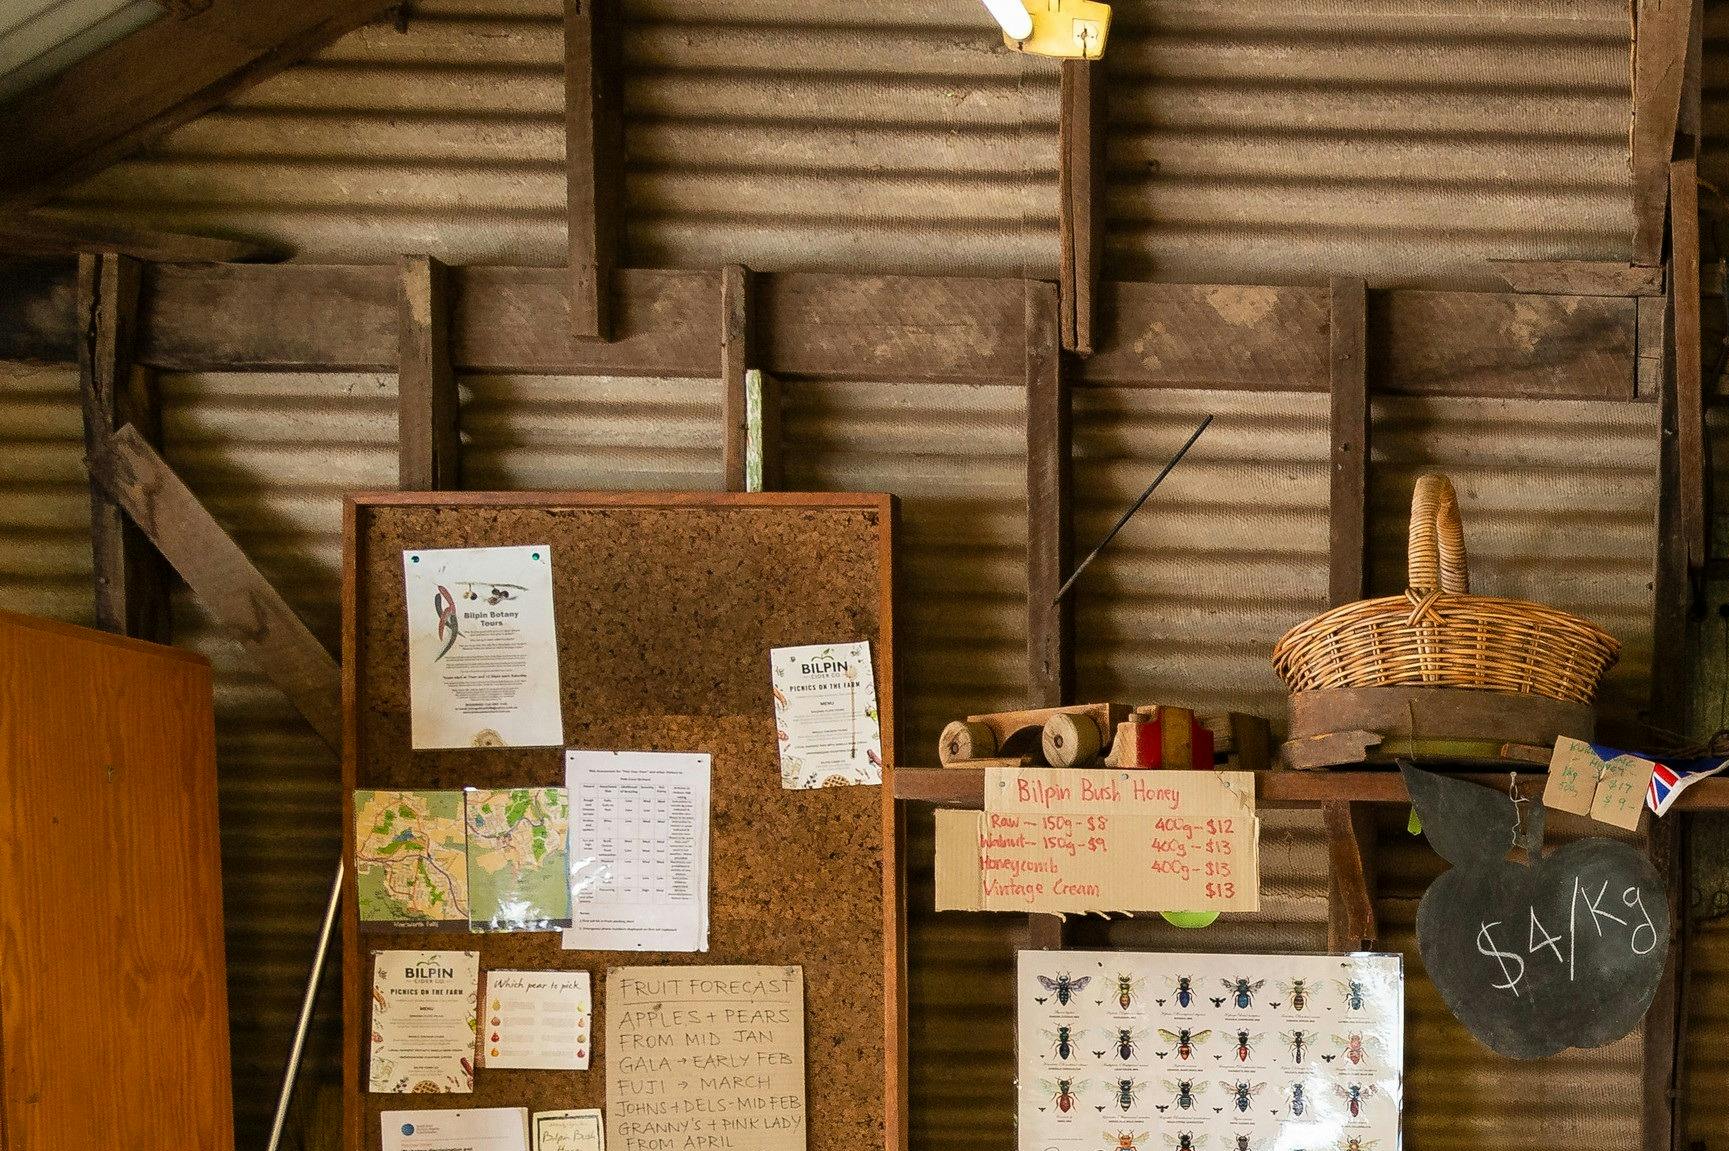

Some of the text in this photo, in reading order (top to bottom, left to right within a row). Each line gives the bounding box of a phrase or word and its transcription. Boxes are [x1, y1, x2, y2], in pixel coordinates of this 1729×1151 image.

[464, 611, 519, 620] Bilpin Botany
[801, 661, 848, 675] BILPIN
[789, 684, 816, 692] PICNICS
[1017, 778, 1181, 810] Bilpin Bush Honey
[990, 814, 1234, 840] Raw 150g $8 400g $12
[1043, 835, 1077, 856] 150g
[1088, 835, 1107, 852] $9
[1151, 838, 1187, 857] 400g
[1205, 840, 1232, 855] $13
[979, 856, 1232, 880] Honeycomb 400g $13
[983, 878, 1235, 903] Vintage Cream $13
[1476, 875, 1657, 997] $4/Kg
[405, 967, 454, 979] BILPIN
[390, 988, 463, 996] PICNICS ON THE FARM
[493, 978, 581, 993] Which pear to pick
[620, 979, 795, 999] FRUIT FORECAST
[618, 1010, 701, 1031] APPLES
[725, 1009, 790, 1024] PEARS
[619, 1029, 774, 1051] FROM MID JAN
[619, 1052, 793, 1074] GALA EARLY FEB
[617, 1075, 771, 1096] FUJI MARCH
[615, 1101, 667, 1118] JOHNS
[770, 1095, 802, 1110] FEB
[618, 1115, 802, 1136] GRANNY'S PINK LADY
[626, 1135, 734, 1151] FROM APRIL
